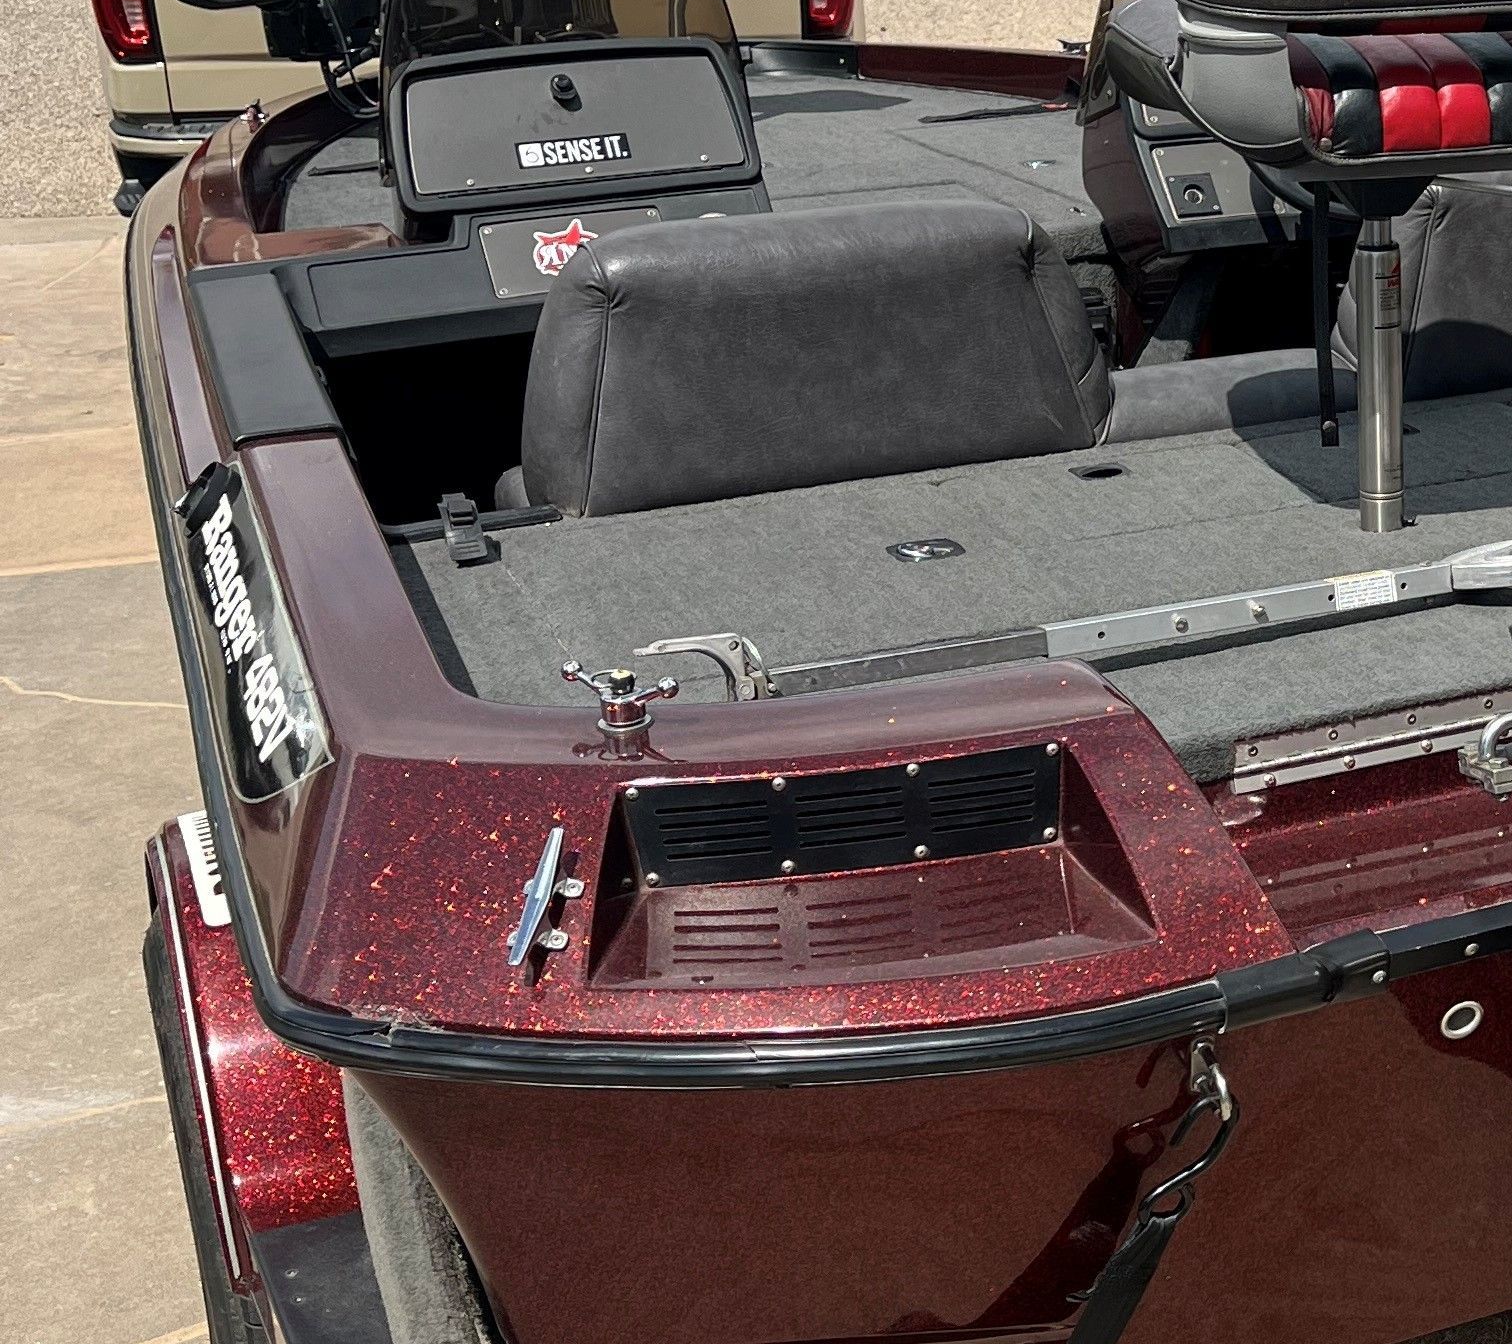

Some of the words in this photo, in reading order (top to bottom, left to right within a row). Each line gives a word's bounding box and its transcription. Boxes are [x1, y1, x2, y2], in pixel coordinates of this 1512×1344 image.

[543, 137, 605, 165] SENSE
[605, 135, 628, 159] IT.
[201, 492, 258, 662] Ranger
